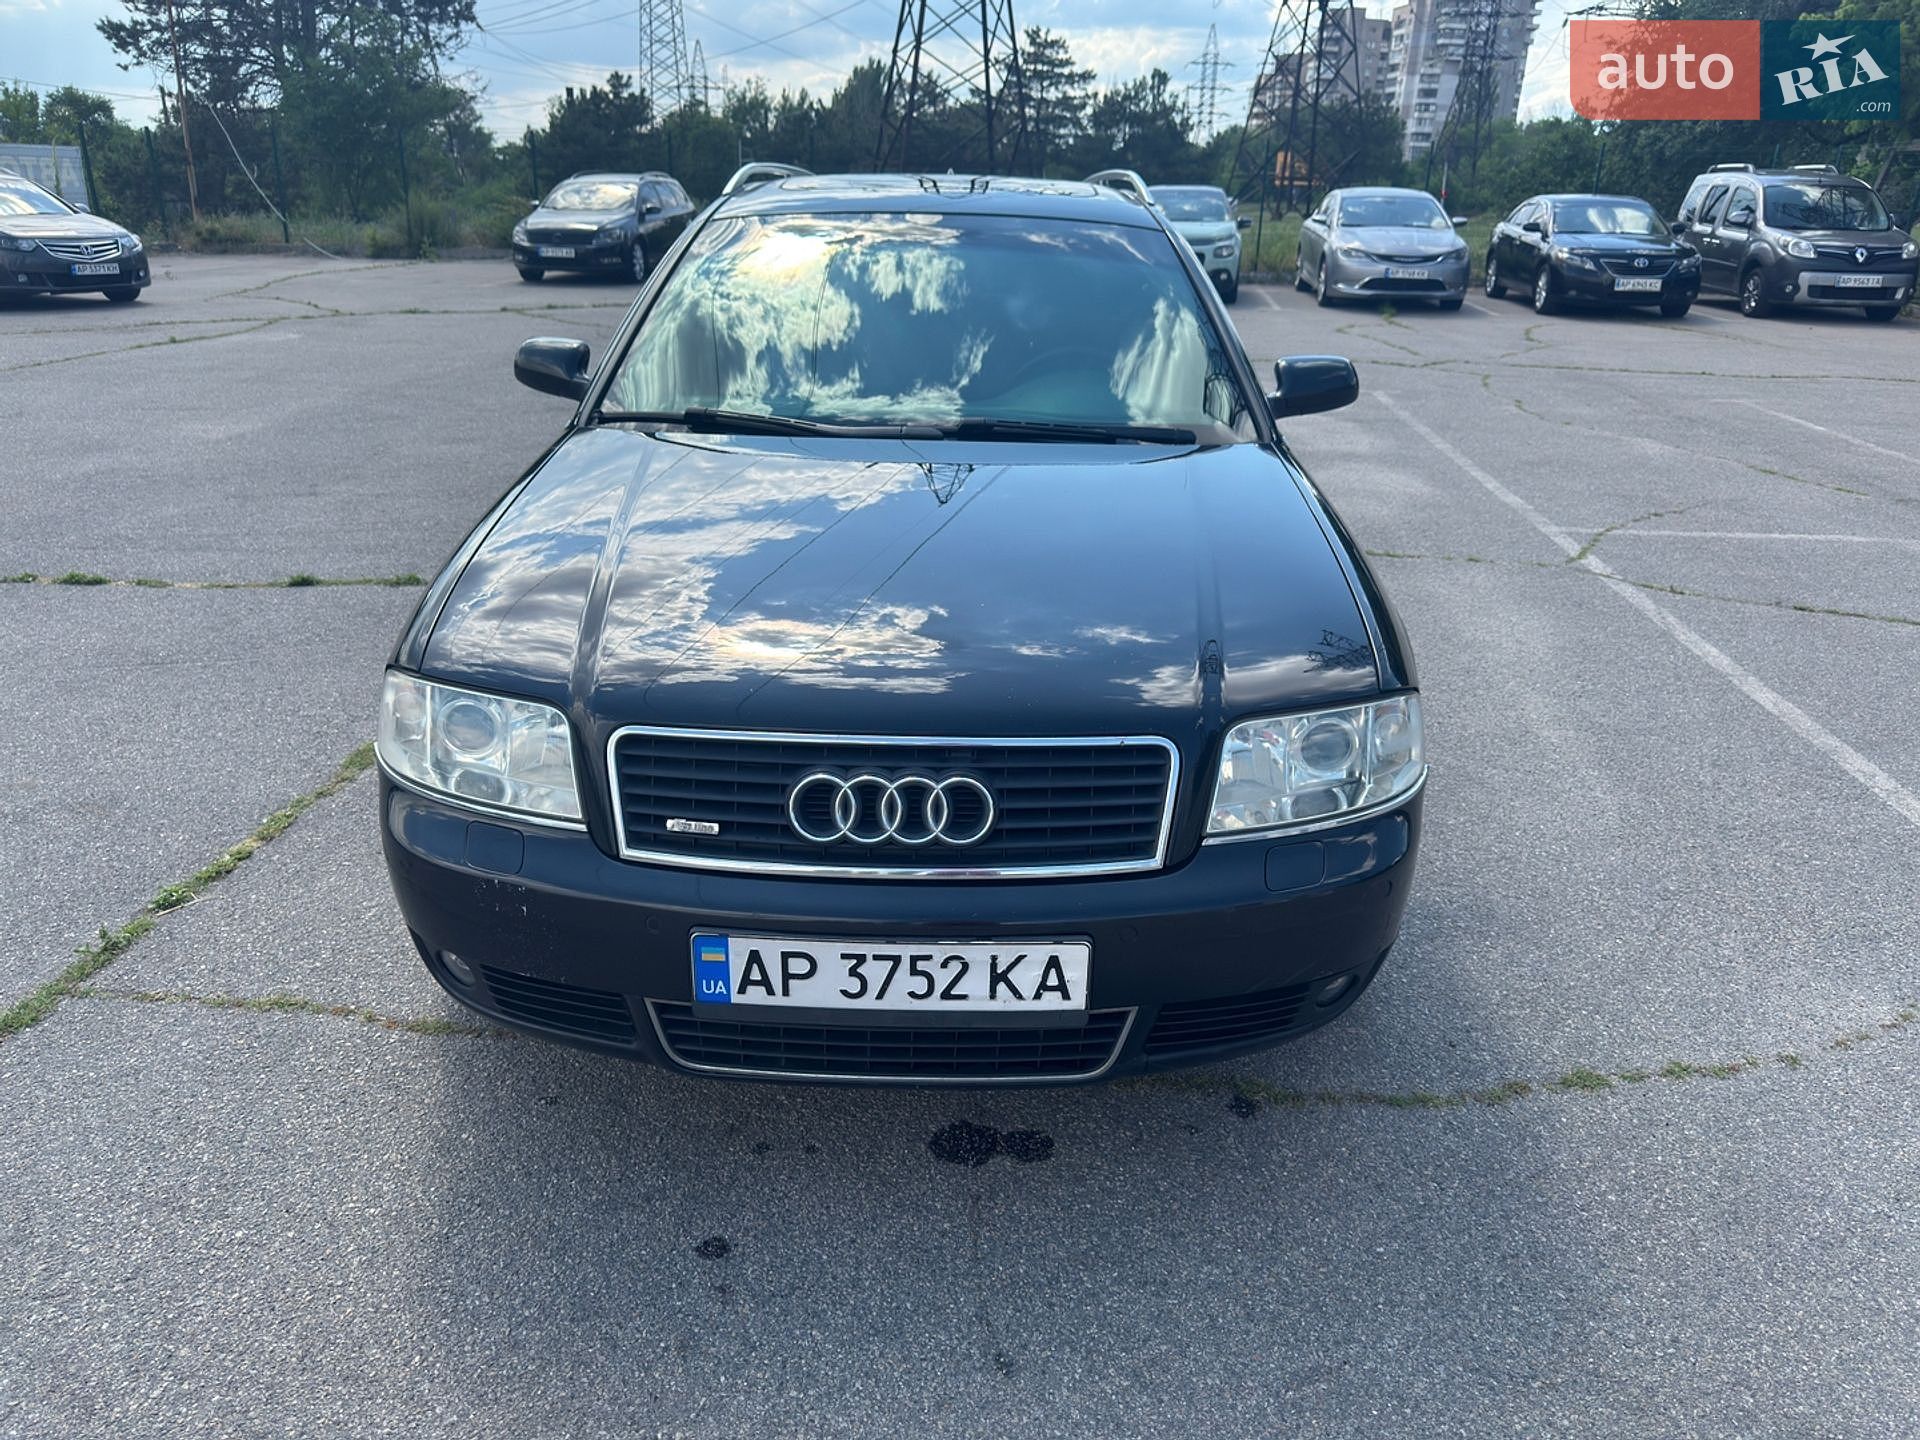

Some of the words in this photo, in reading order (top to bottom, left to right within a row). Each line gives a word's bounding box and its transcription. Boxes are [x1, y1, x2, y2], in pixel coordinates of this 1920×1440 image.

[702, 979, 728, 996] UA
[736, 949, 817, 998] AP
[839, 953, 970, 1001] 3752
[989, 954, 1072, 1001] KA
